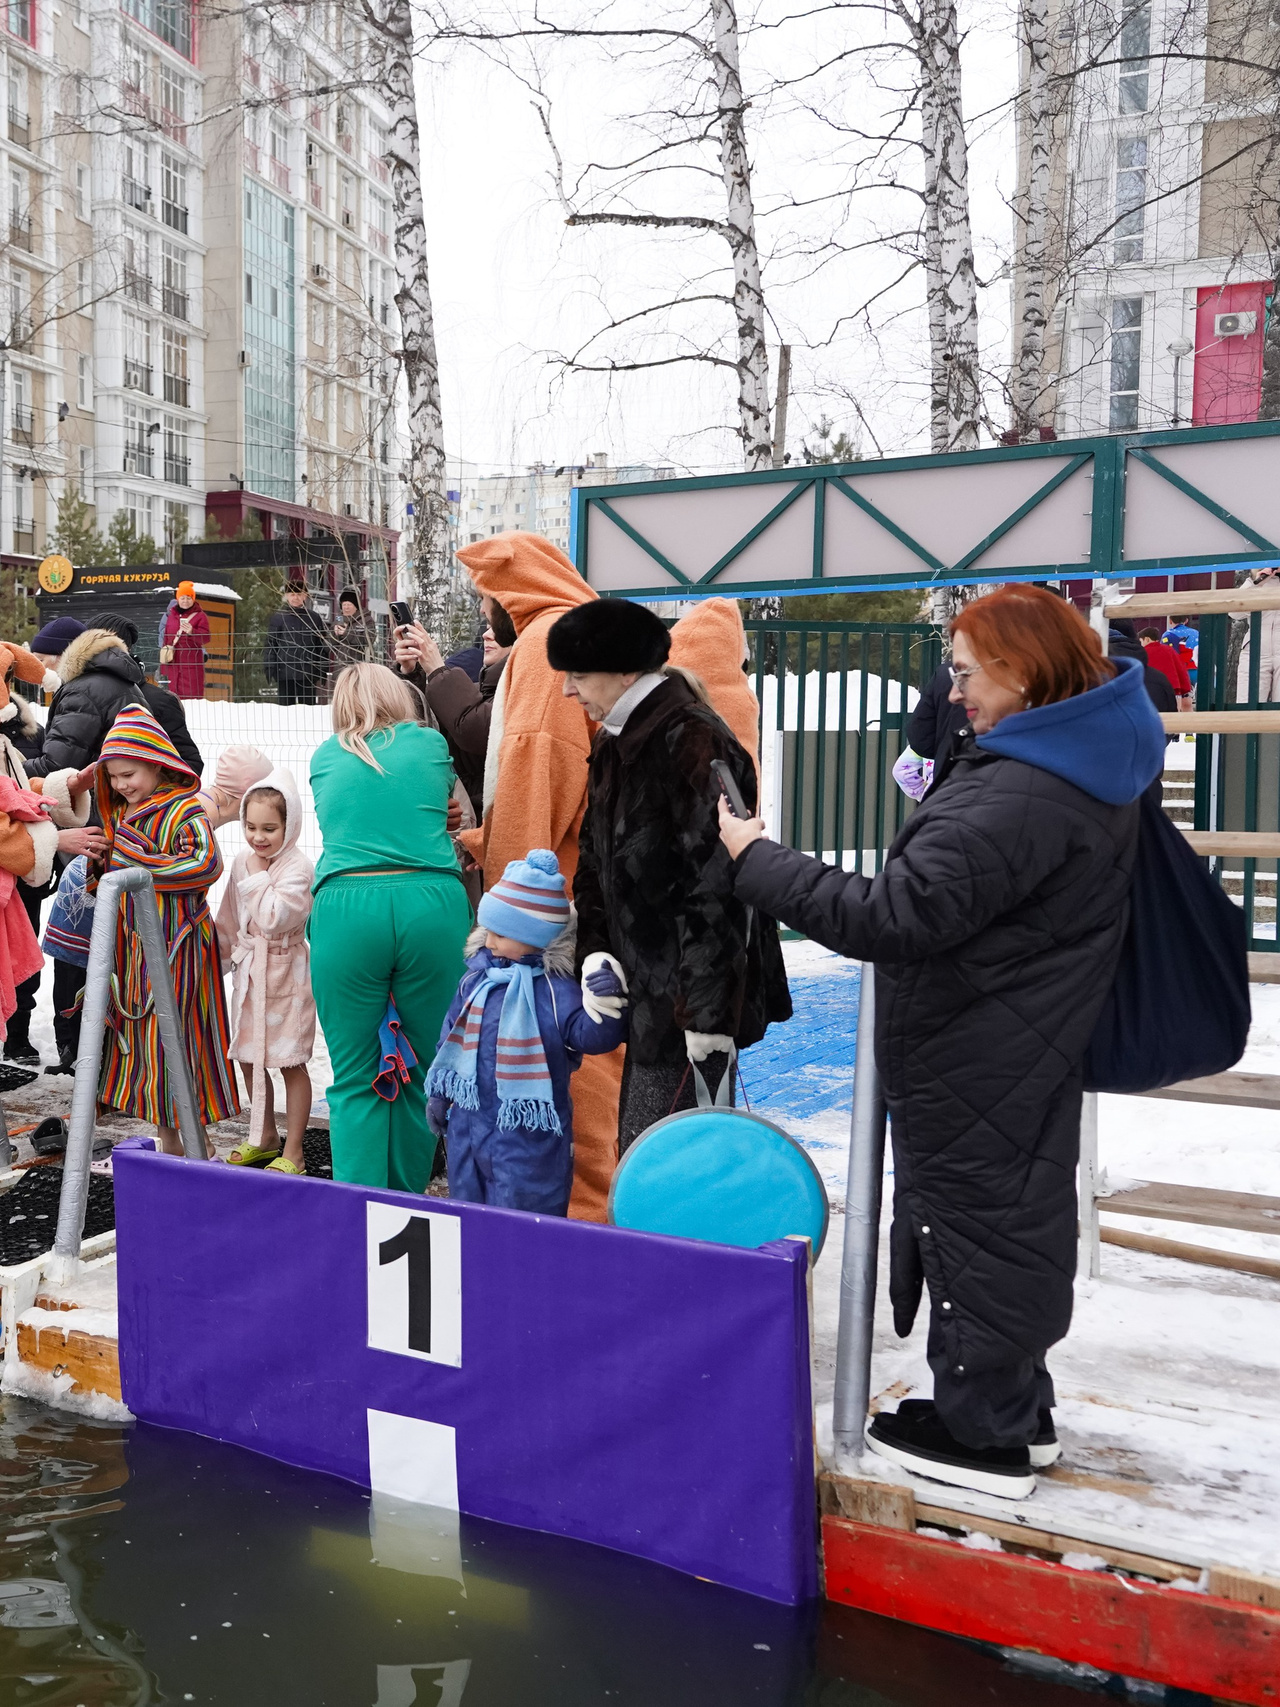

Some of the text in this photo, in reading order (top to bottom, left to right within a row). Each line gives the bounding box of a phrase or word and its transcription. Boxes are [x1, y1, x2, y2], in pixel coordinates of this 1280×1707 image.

[80, 572, 170, 584] ГОРЯЧАЯ КУКУРУЗА
[379, 1215, 431, 1354] 1
